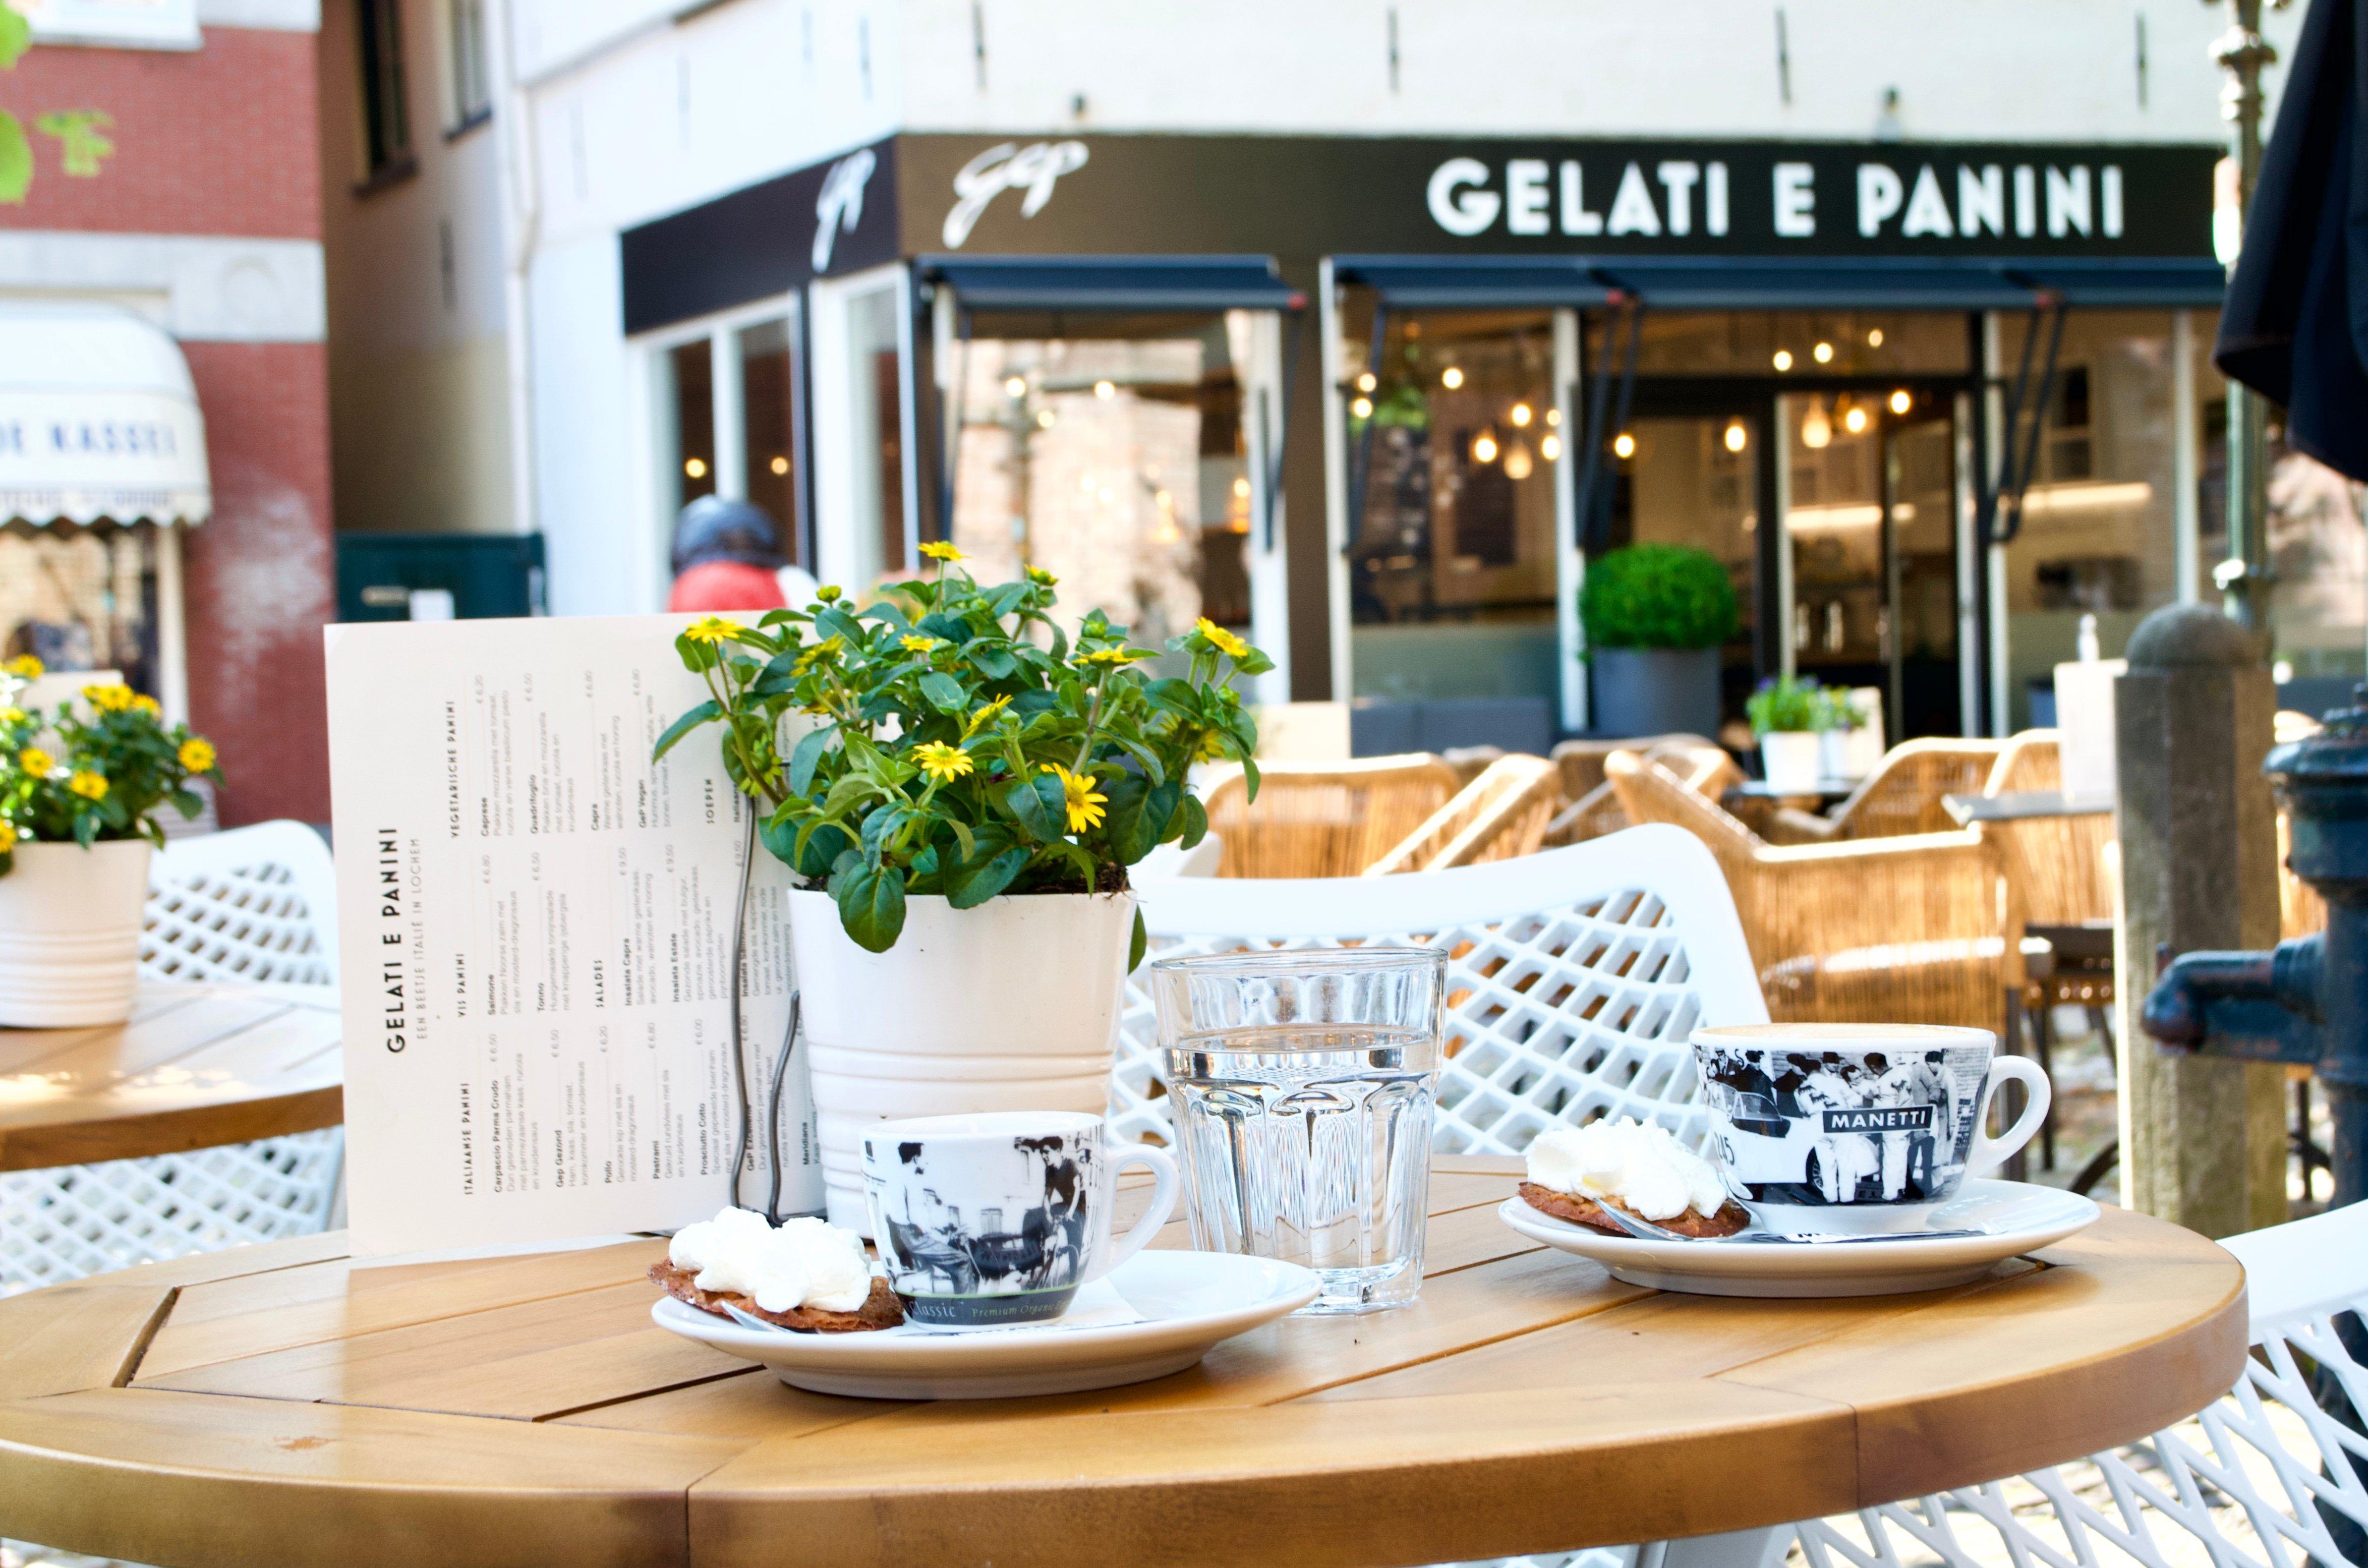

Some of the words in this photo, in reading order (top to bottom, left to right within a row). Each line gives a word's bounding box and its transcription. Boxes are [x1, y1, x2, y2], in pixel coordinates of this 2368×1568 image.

[1426, 158, 1729, 236] GELATI
[1772, 163, 1815, 236] E
[1857, 163, 2124, 238] PANINI
[446, 701, 456, 741] PANINI
[447, 748, 459, 837] VEGETARISCHE
[704, 779, 715, 824] SOEPEN
[480, 797, 491, 836] Caprese
[591, 804, 601, 831] Capra
[378, 829, 400, 916] PANINI
[410, 839, 422, 893] LOCHEM
[412, 901, 422, 913] IN
[382, 934, 401, 944] E
[411, 920, 424, 960] ITALIË
[622, 938, 632, 966] Capra
[669, 933, 677, 962] Estate
[414, 967, 426, 1009] BEETJE
[455, 953, 466, 994] PANINI
[594, 959, 604, 1008] SALADES
[623, 969, 632, 1006] Insalata
[670, 966, 679, 1002] Insalata
[383, 962, 406, 1053] GELATI
[457, 1000, 467, 1017] VIS
[487, 974, 495, 1015] Salmone
[537, 982, 545, 1012] Tonno
[416, 1017, 427, 1039] EEN
[460, 1083, 471, 1123] PANINI
[491, 1080, 499, 1110] Crudo
[492, 1113, 500, 1142] Parma
[698, 1103, 706, 1127] Cotto
[1832, 1110, 1925, 1128] MANETTI
[462, 1130, 473, 1194] ITALIAANSE
[555, 1130, 563, 1165] Gezond
[652, 1140, 660, 1179] Pastrami
[699, 1130, 708, 1175] Prosciutto
[801, 1122, 810, 1165] Meridiana
[493, 1145, 504, 1192] Carpaccio
[556, 1169, 566, 1187] Gep
[605, 1160, 613, 1183] Pollo
[909, 1301, 956, 1317] Classic
[972, 1307, 1017, 1317] Premium
